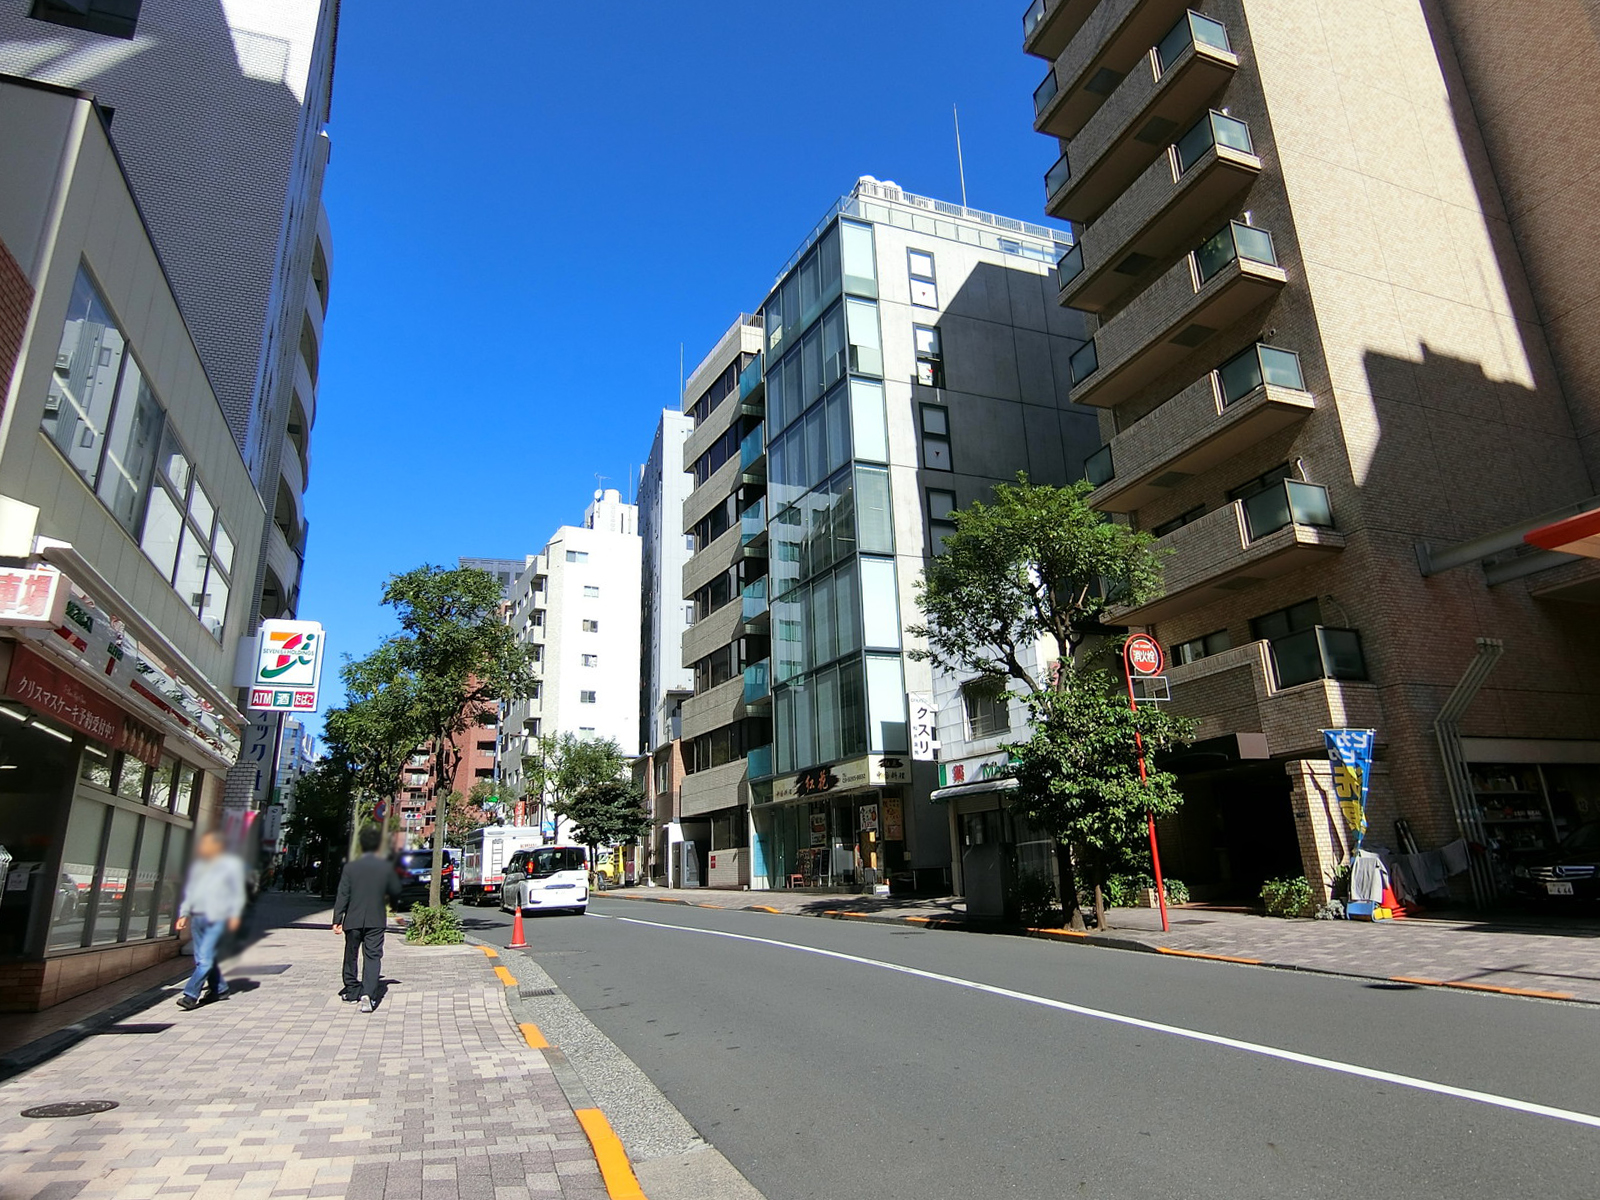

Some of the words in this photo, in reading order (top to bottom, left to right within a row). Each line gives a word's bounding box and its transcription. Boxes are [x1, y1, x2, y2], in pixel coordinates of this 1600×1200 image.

[1132, 650, 1156, 663] 消火栓
[252, 695, 273, 705] ATM
[276, 693, 291, 706] 酒
[295, 694, 315, 706] たばこ
[917, 707, 931, 754] クスリ
[952, 764, 965, 784] 薬
